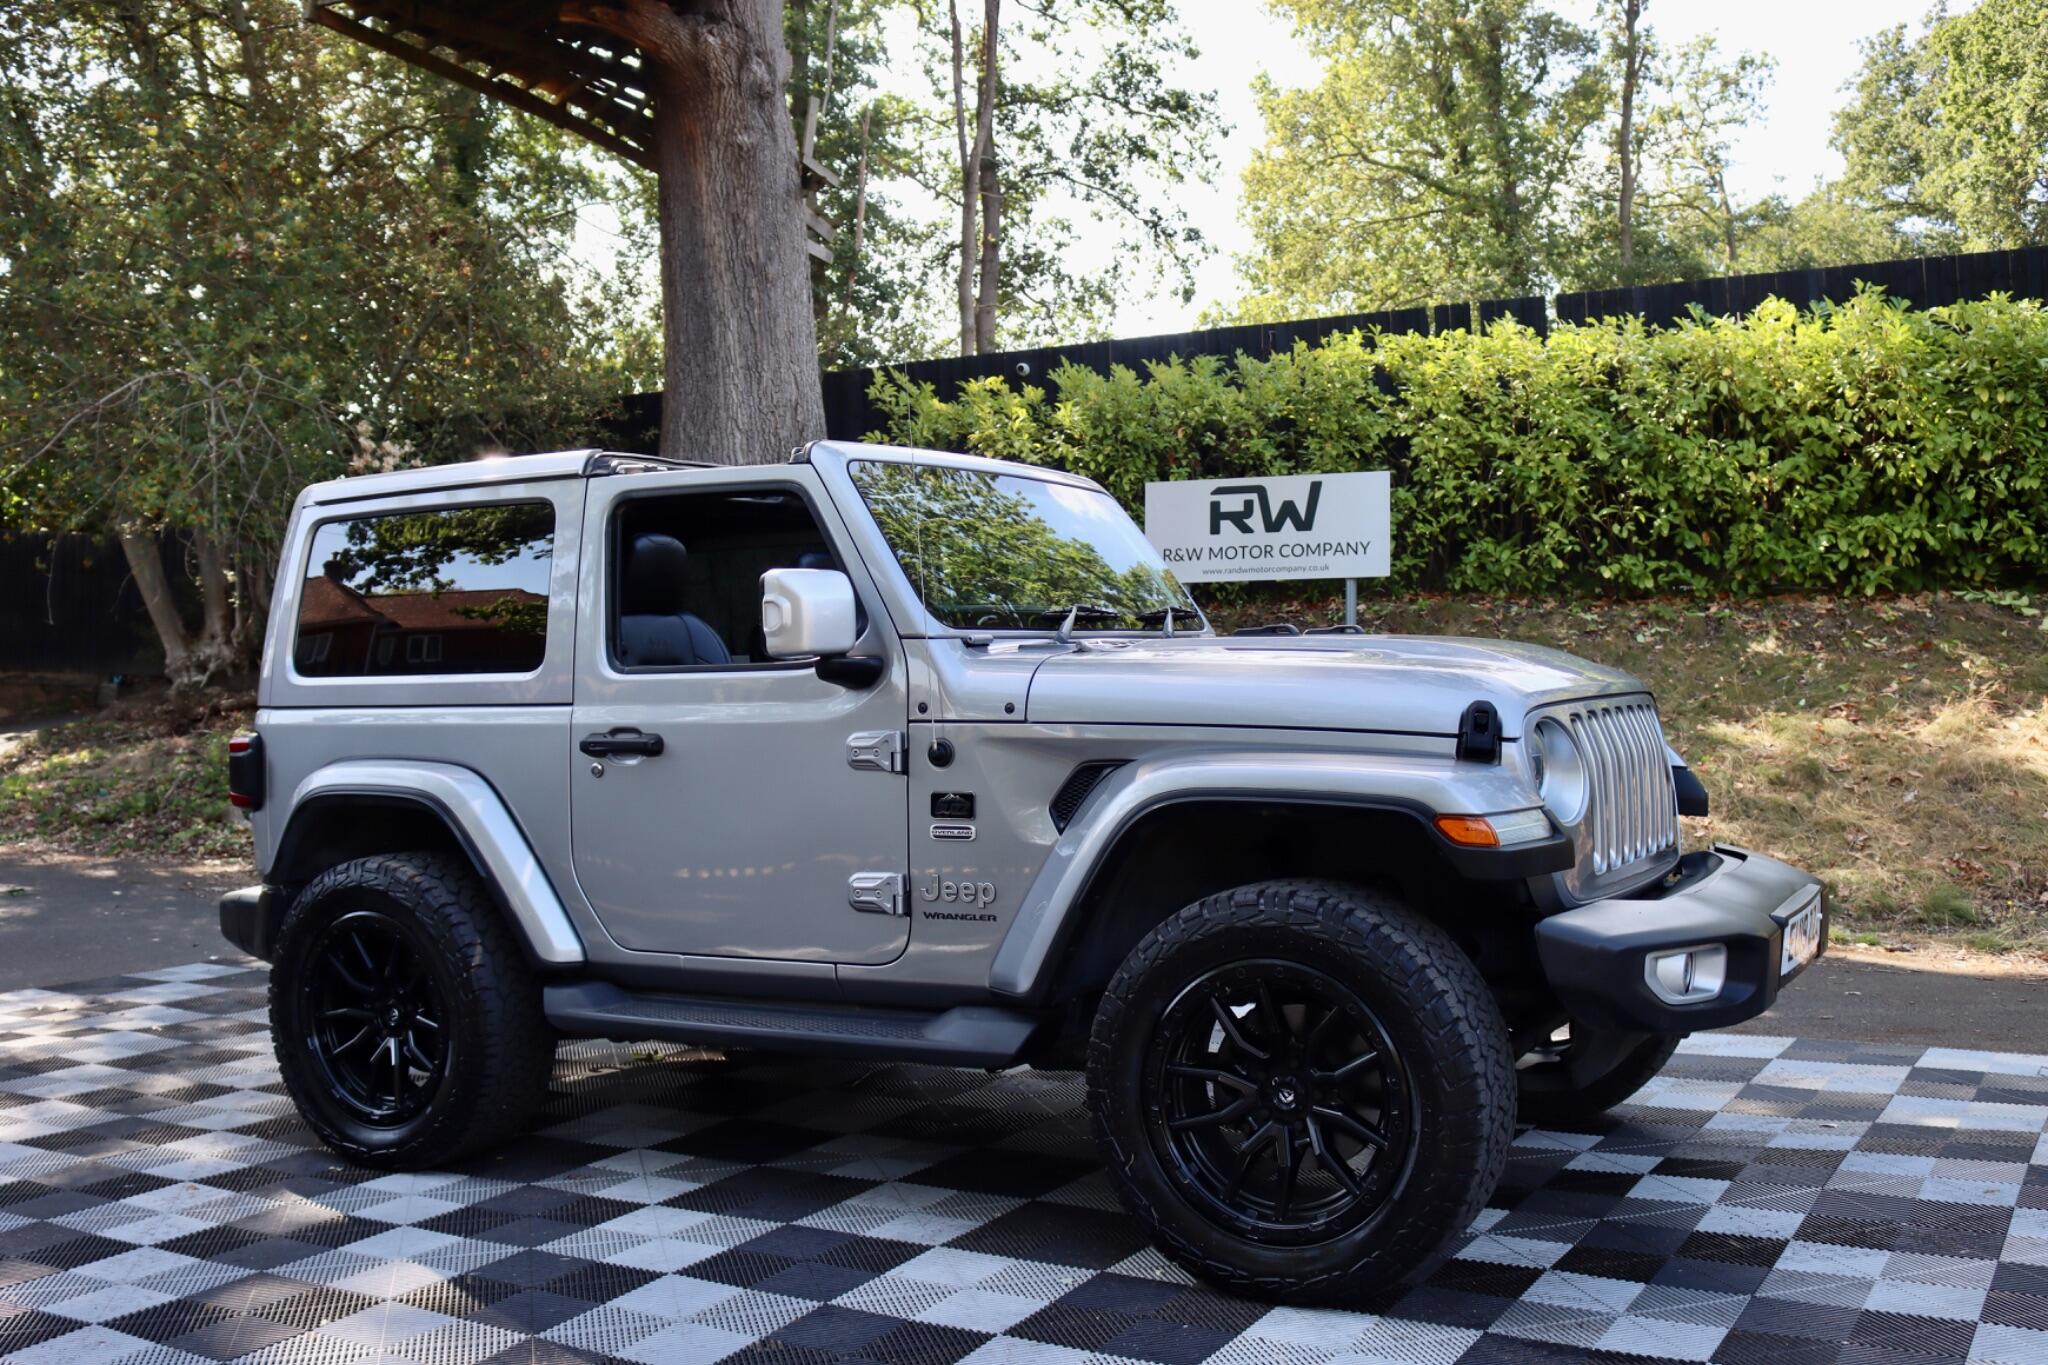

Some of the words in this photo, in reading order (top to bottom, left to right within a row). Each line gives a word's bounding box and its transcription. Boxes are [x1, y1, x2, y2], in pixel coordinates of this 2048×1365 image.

[1210, 481, 1323, 535] RW
[1163, 547, 1203, 562] R&W
[1208, 545, 1274, 561] MOTOR
[1279, 541, 1371, 558] COMPANY
[1202, 564, 1330, 576] www.randwmotorcompany.co.uk
[921, 874, 996, 908] Jeep
[923, 911, 997, 922] WRANGLER
